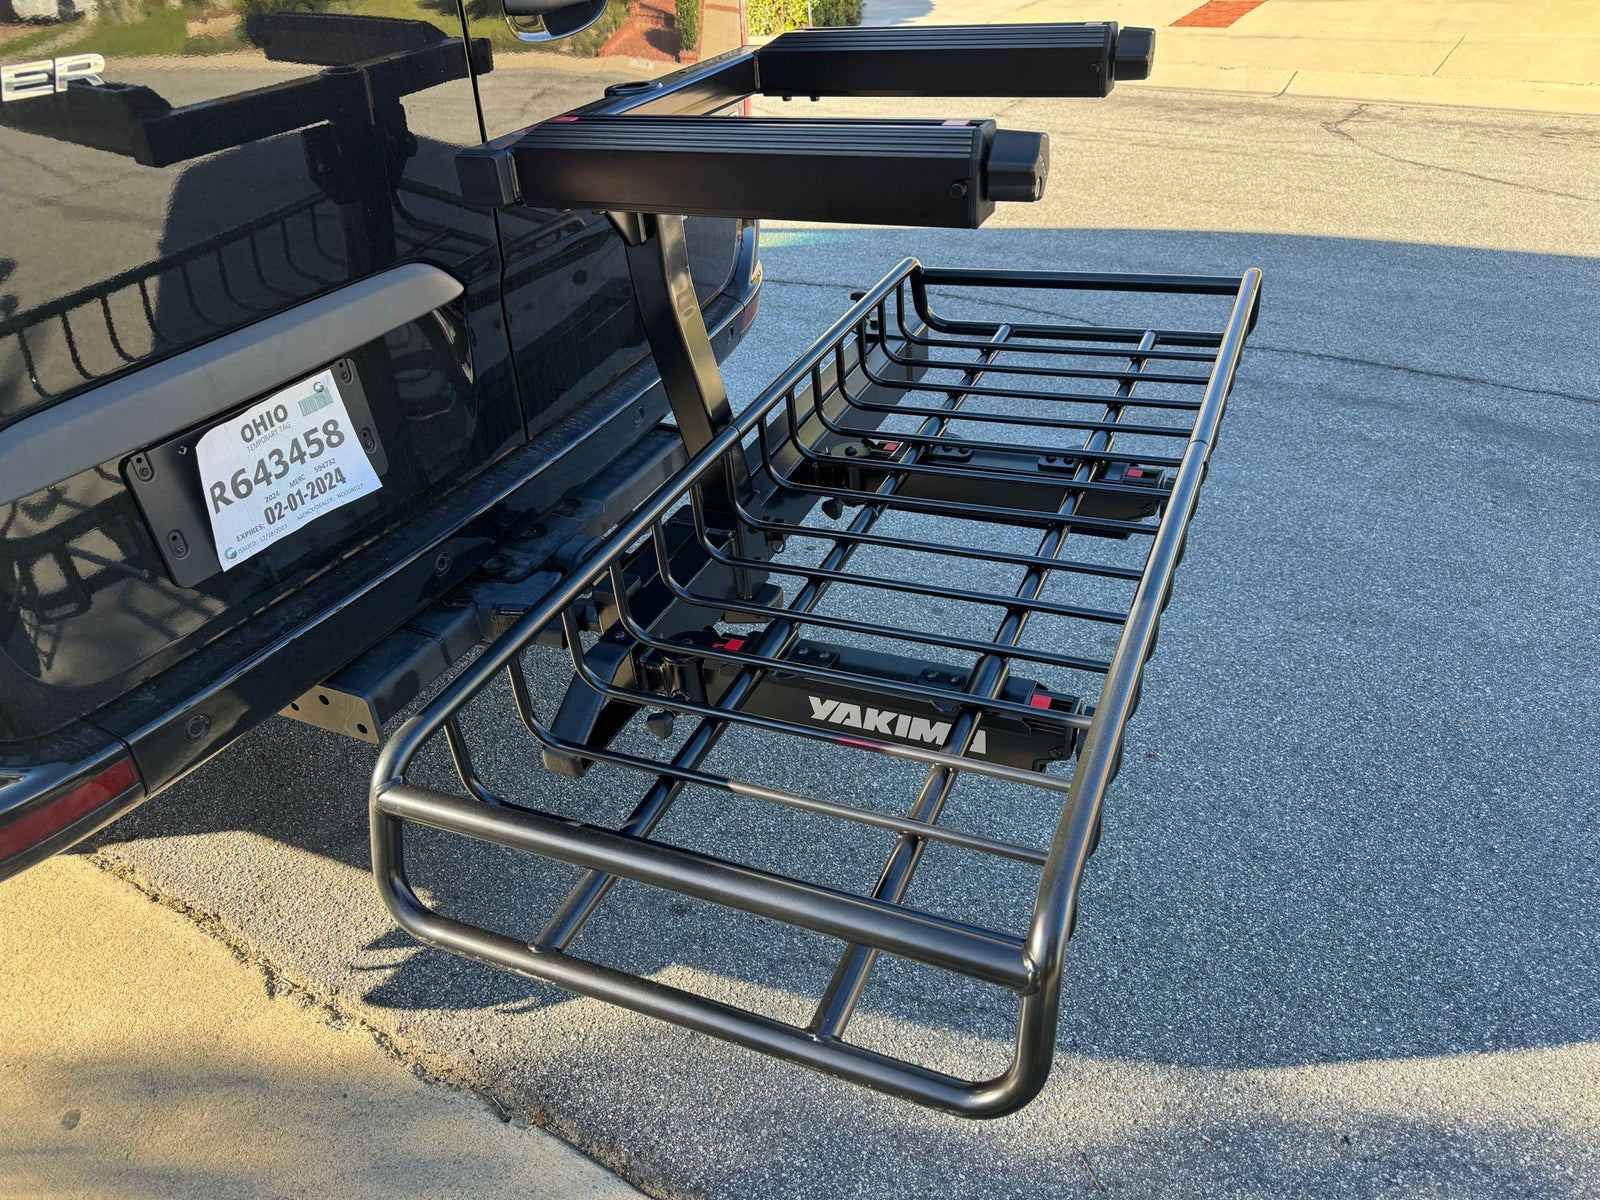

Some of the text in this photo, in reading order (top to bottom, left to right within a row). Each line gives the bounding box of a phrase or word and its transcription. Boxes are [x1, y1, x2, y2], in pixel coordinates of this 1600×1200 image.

[1, 53, 105, 101] ER
[241, 404, 288, 443] OHIO
[246, 421, 291, 453] TEMPORARY TAG
[209, 419, 345, 514] R643458
[265, 457, 337, 503] 2024 MERC 594732
[236, 467, 347, 542] EXPIRES: 02-01-2024
